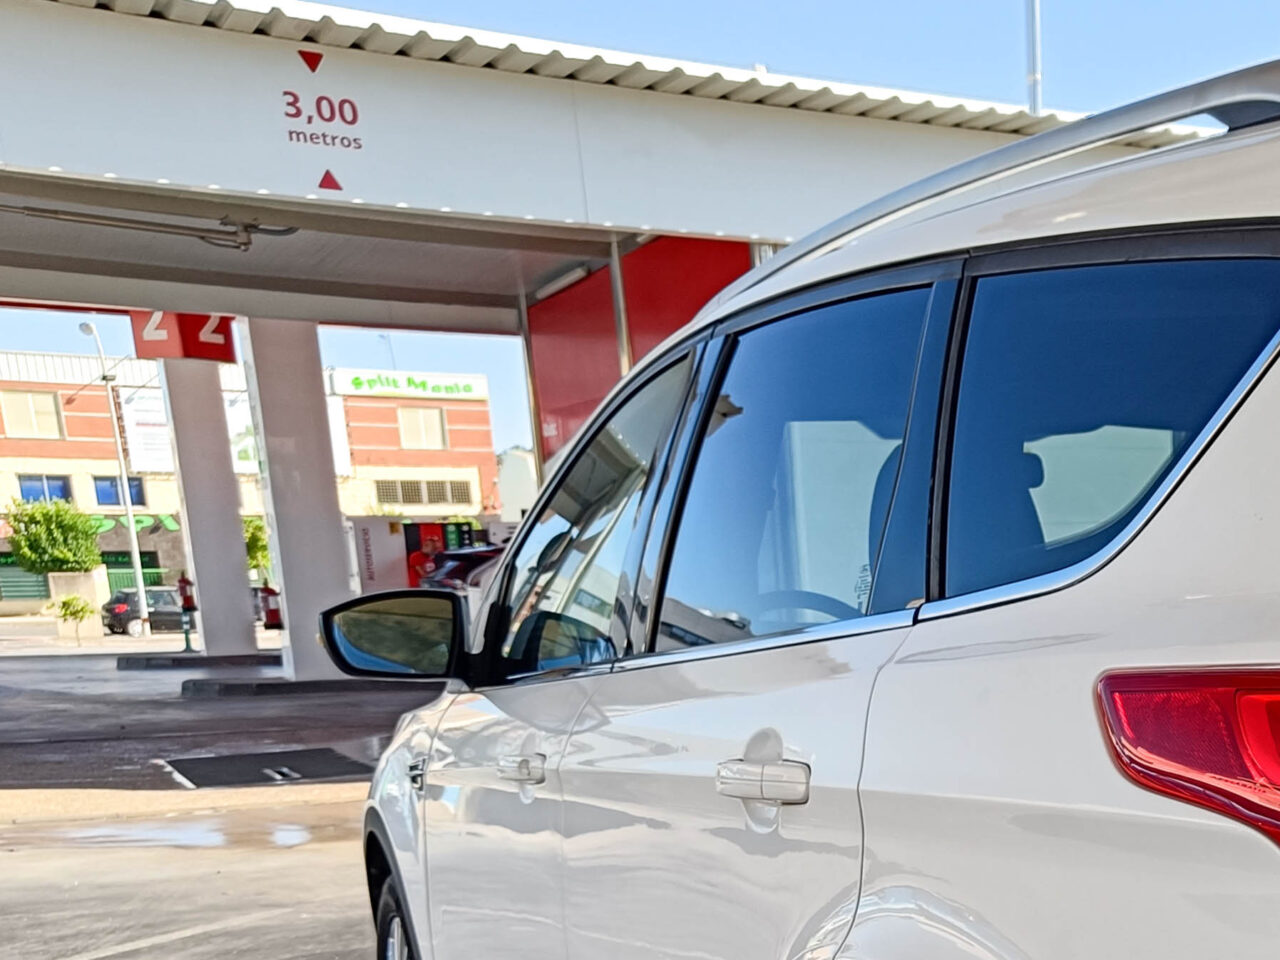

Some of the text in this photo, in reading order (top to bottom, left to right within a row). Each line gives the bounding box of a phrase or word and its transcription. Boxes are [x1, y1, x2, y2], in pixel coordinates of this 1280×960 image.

[282, 90, 359, 126] 3,00
[288, 129, 363, 150] metros
[351, 374, 473, 394] Split Mania
